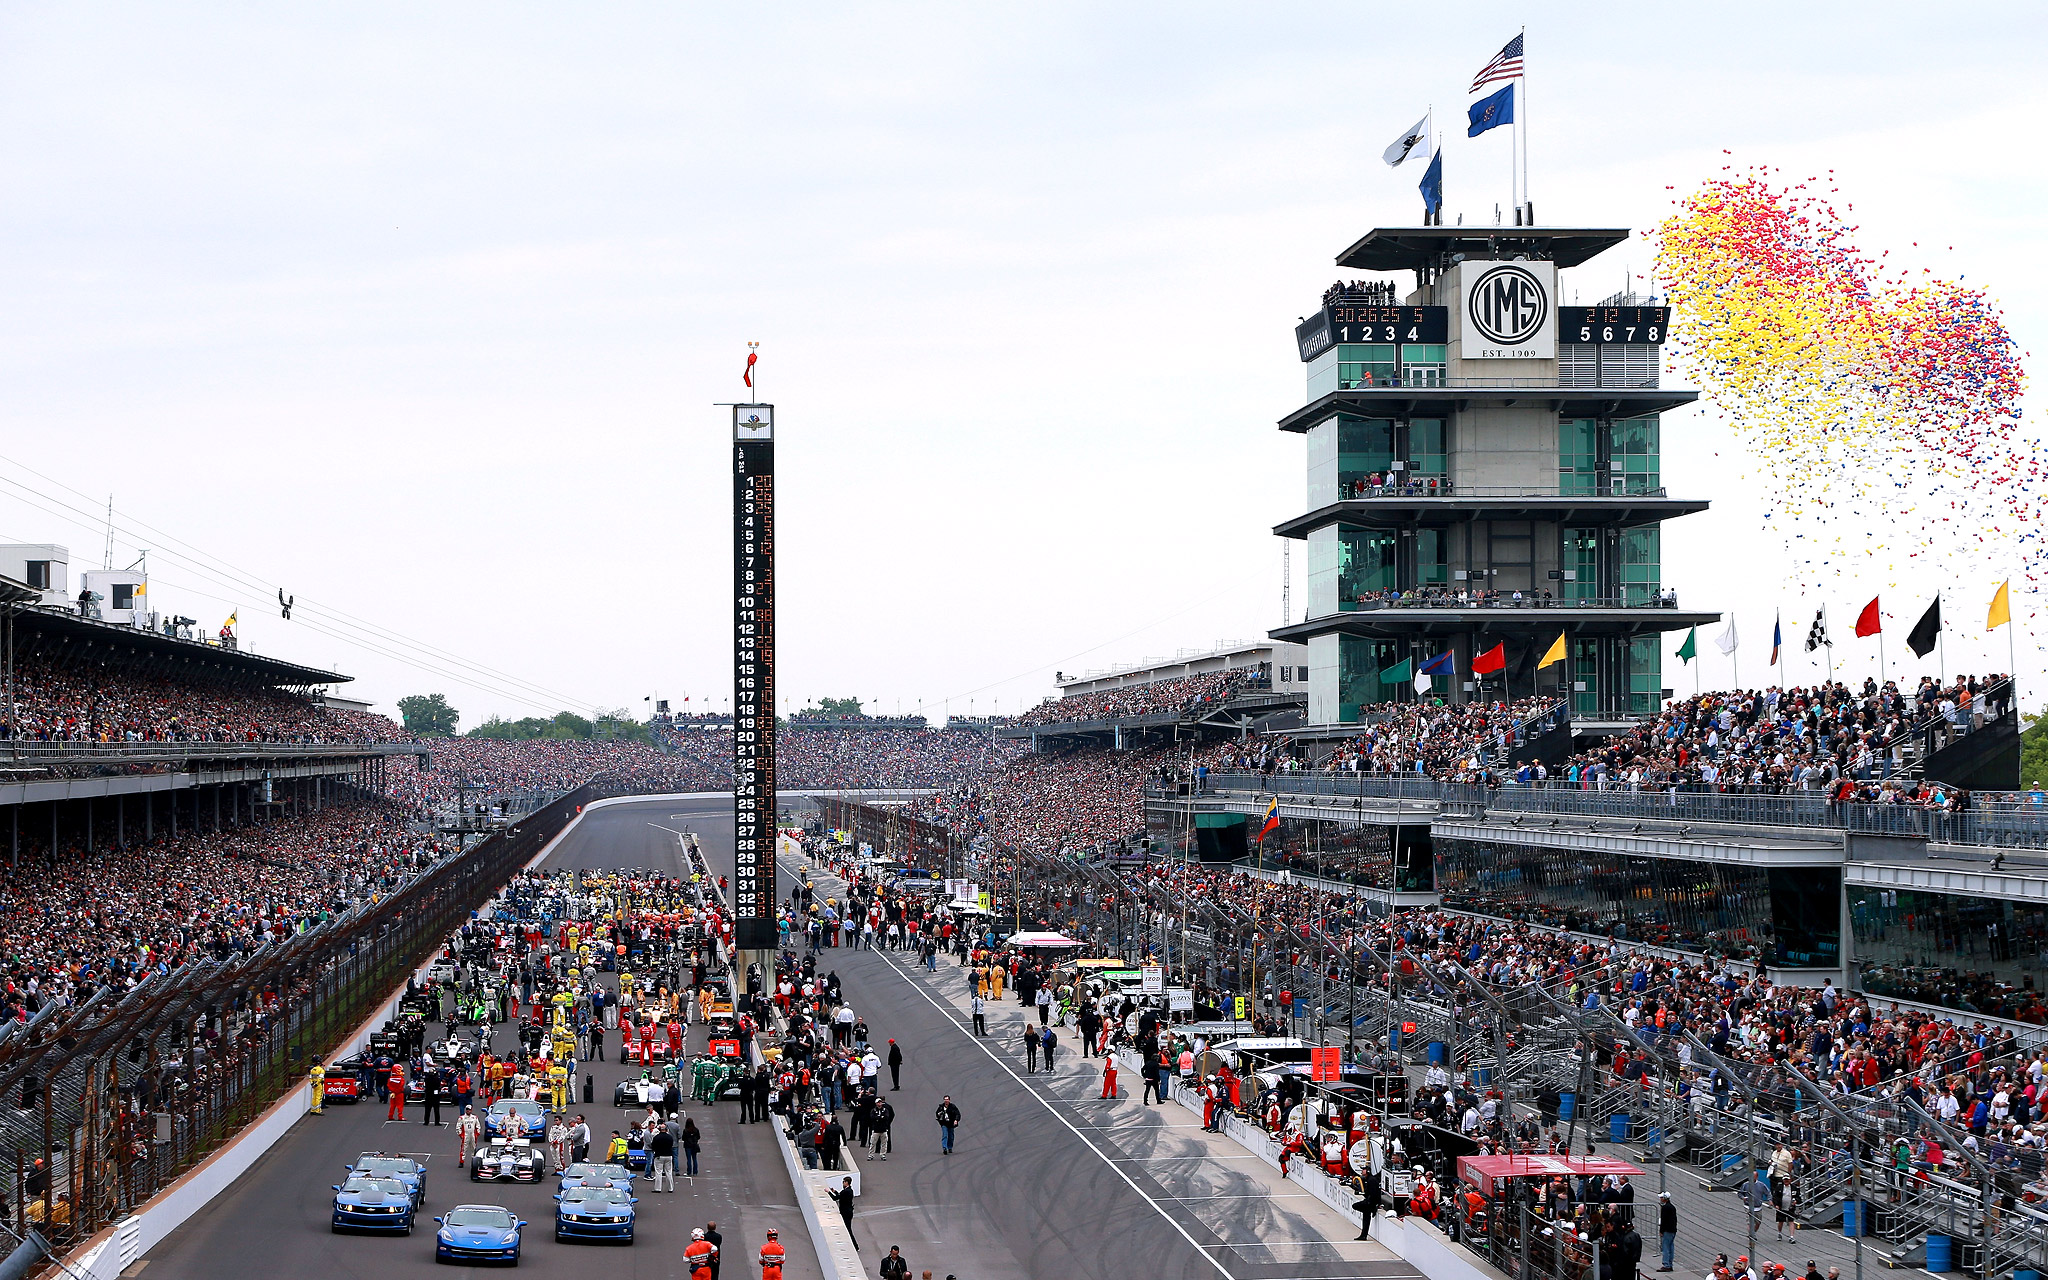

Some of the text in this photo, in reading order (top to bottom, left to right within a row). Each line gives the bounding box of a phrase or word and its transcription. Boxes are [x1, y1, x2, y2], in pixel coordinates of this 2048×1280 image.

[1483, 276, 1537, 334] IMS
[1335, 308, 1423, 322] 20 26 25 5
[1586, 309, 1595, 322] 2
[1604, 309, 1618, 322] 12
[1655, 309, 1664, 322] 3
[1340, 326, 1419, 342] 1 2 3 4
[1580, 327, 1659, 341] 5 6 7 8
[747, 477, 753, 486] 1
[746, 490, 753, 499] 2
[746, 503, 753, 513] 3
[745, 517, 753, 527] 4
[746, 530, 753, 540] 5
[746, 544, 754, 553] 6
[746, 557, 754, 567] 7
[746, 571, 754, 580] 8
[746, 584, 754, 593] 9
[738, 597, 754, 607] 10
[740, 611, 754, 620] 11
[738, 624, 754, 634] 12
[738, 638, 754, 647] 13
[739, 651, 754, 661] 14
[739, 665, 754, 674] 15
[739, 678, 754, 688] 16
[739, 692, 754, 701] 17
[739, 705, 754, 714] 18
[739, 718, 754, 728] 19
[738, 732, 754, 741] 20
[738, 745, 755, 755] 21
[737, 785, 755, 795] 24
[738, 799, 755, 809] 25
[738, 813, 755, 822] 26
[739, 826, 755, 836] 27
[738, 840, 755, 850] 28
[738, 853, 755, 863] 29
[738, 867, 755, 876] 30
[739, 880, 755, 890] 31
[738, 893, 755, 903] 32
[738, 907, 755, 917] 33
